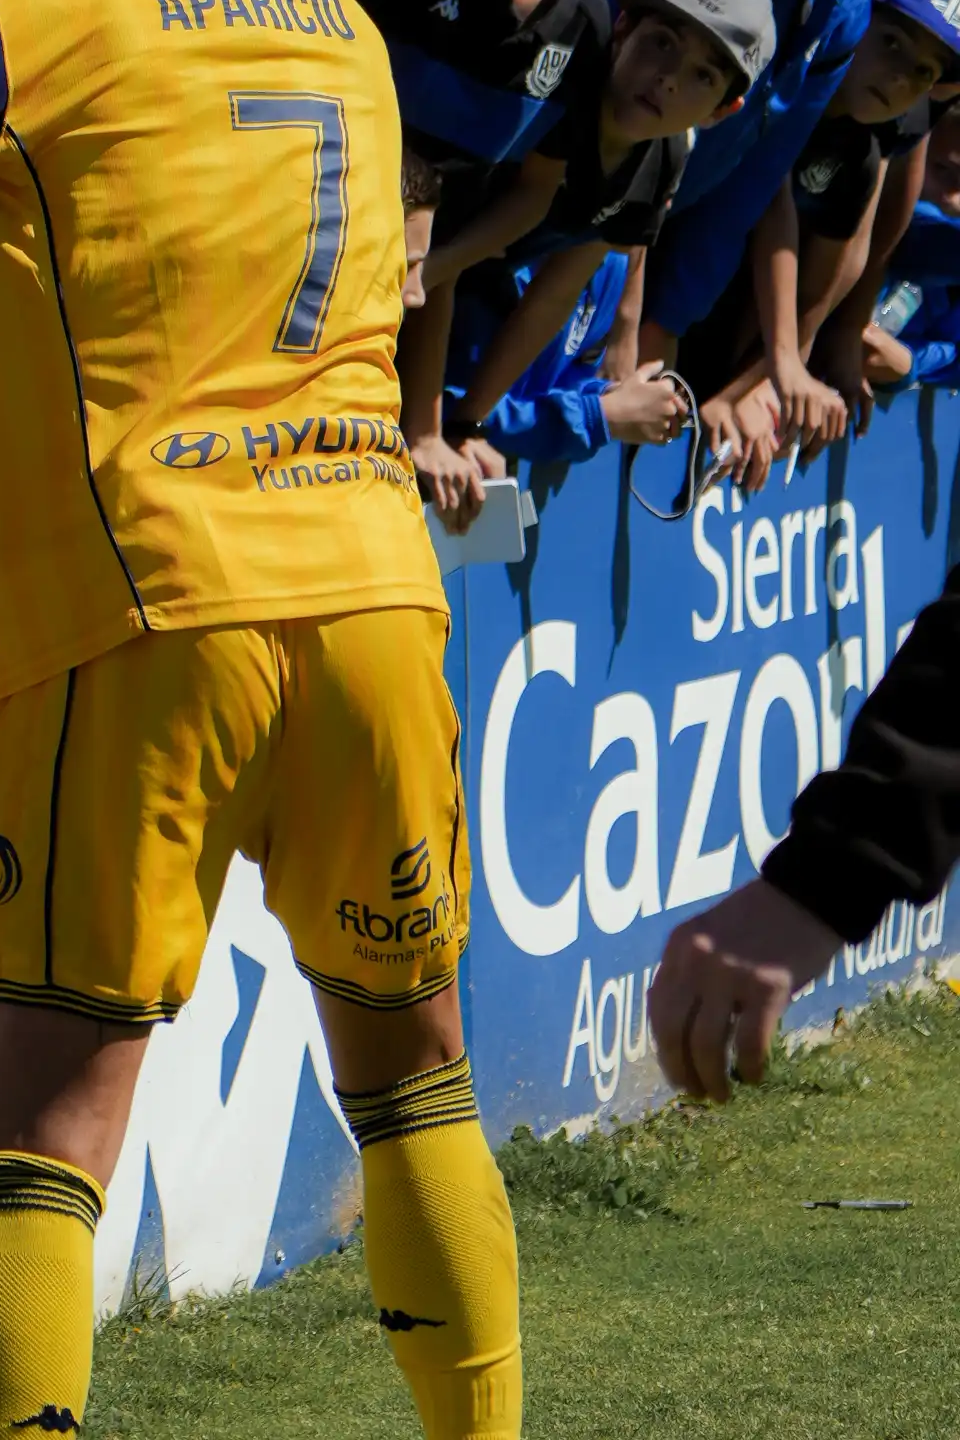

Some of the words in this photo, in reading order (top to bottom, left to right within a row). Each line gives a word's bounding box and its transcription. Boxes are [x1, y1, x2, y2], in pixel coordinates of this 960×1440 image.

[228, 91, 350, 354] 7
[241, 417, 413, 461] HYUNDA
[252, 460, 360, 492] Yuncar
[692, 486, 858, 642] Sierra
[480, 523, 916, 957] Cazorl
[353, 943, 424, 965] Alarmas
[562, 958, 662, 1103] Agu
